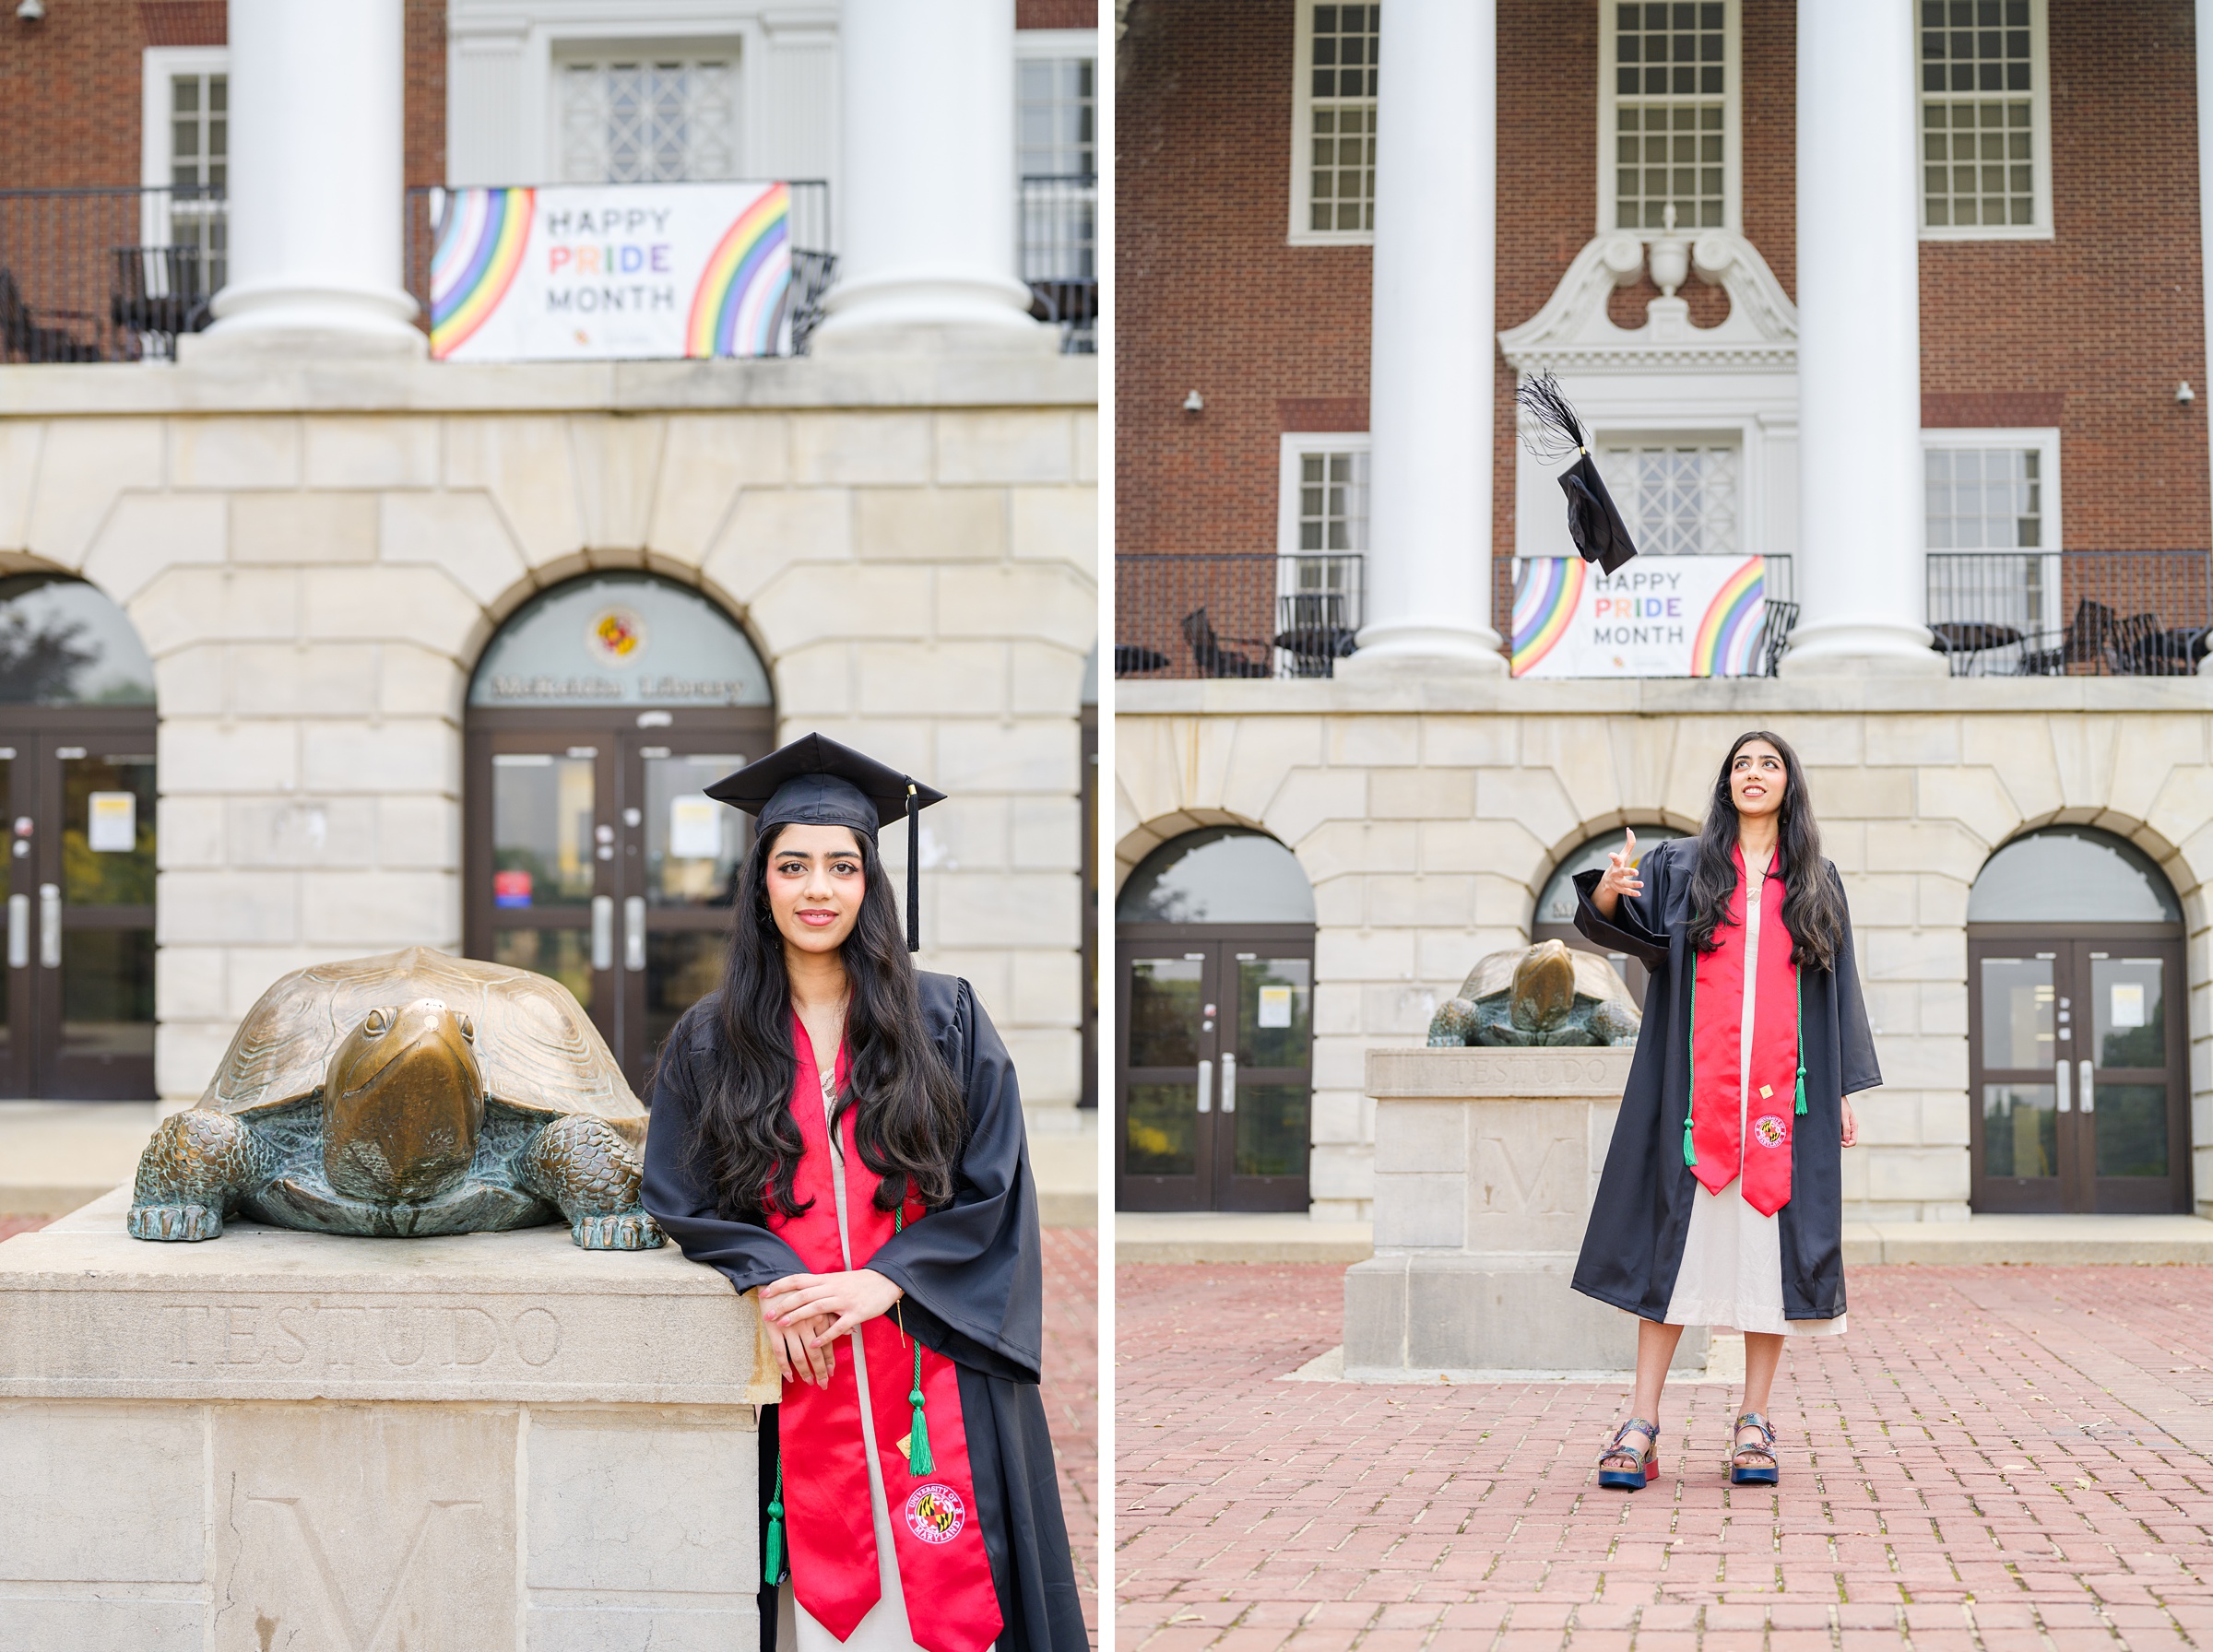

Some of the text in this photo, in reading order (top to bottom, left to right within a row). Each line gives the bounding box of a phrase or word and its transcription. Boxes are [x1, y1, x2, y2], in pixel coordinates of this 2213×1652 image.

[548, 209, 670, 236] HAPPY
[550, 245, 673, 275] PRIDE
[547, 287, 674, 313] MONTH
[1594, 572, 1681, 591] HAPPY
[1595, 598, 1682, 618] PRIDE
[1593, 626, 1684, 644] MONTH
[1450, 1058, 1607, 1084] TESTUDO
[160, 1304, 563, 1366] TESTUDO
[909, 1486, 958, 1507] UNIVERSITY OF
[915, 1521, 960, 1541] MARYLAND
